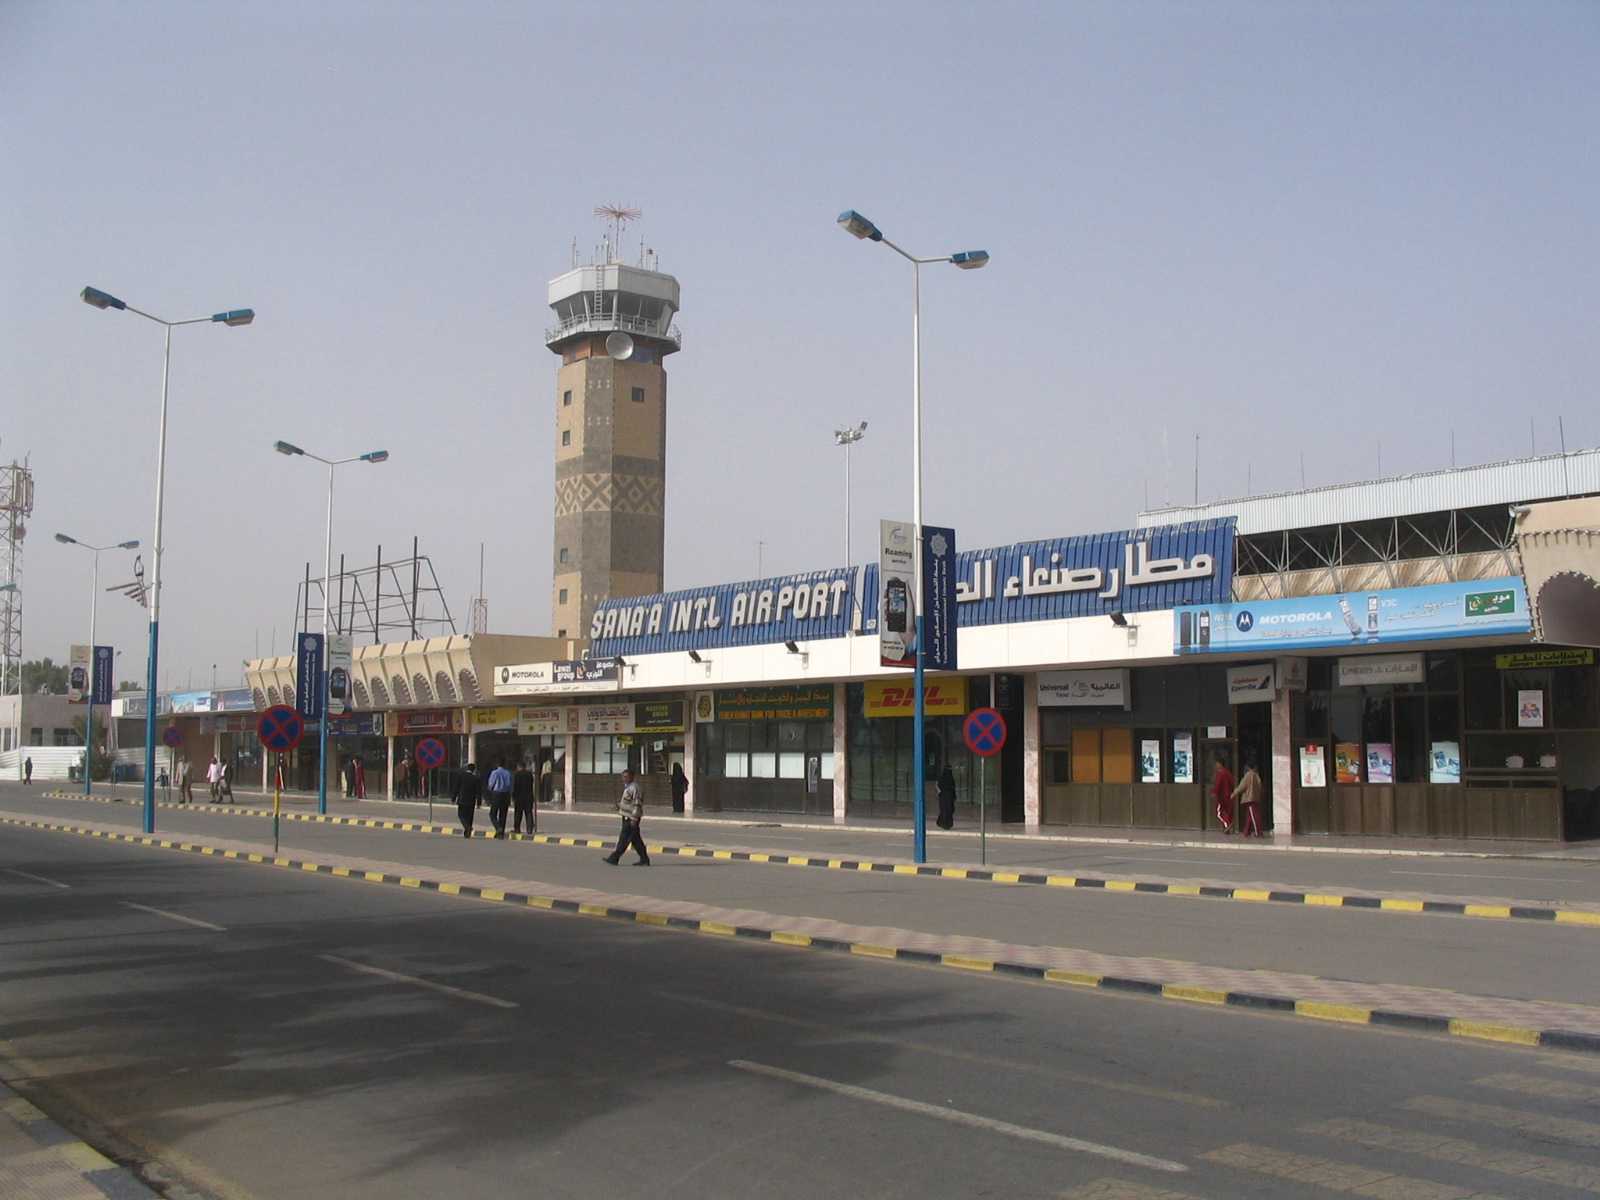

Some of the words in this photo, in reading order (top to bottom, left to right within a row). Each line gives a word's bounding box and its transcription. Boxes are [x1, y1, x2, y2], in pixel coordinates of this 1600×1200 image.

[885, 547, 913, 559] Roaming
[1003, 552, 1102, 598] صنعاء
[1099, 541, 1213, 598] مطار
[590, 602, 663, 640] SANA'A
[731, 580, 847, 627] AIRPORT
[1259, 611, 1333, 625] MOTOROLA
[511, 671, 545, 680] MOTOROLA
[880, 686, 945, 708] DHL
